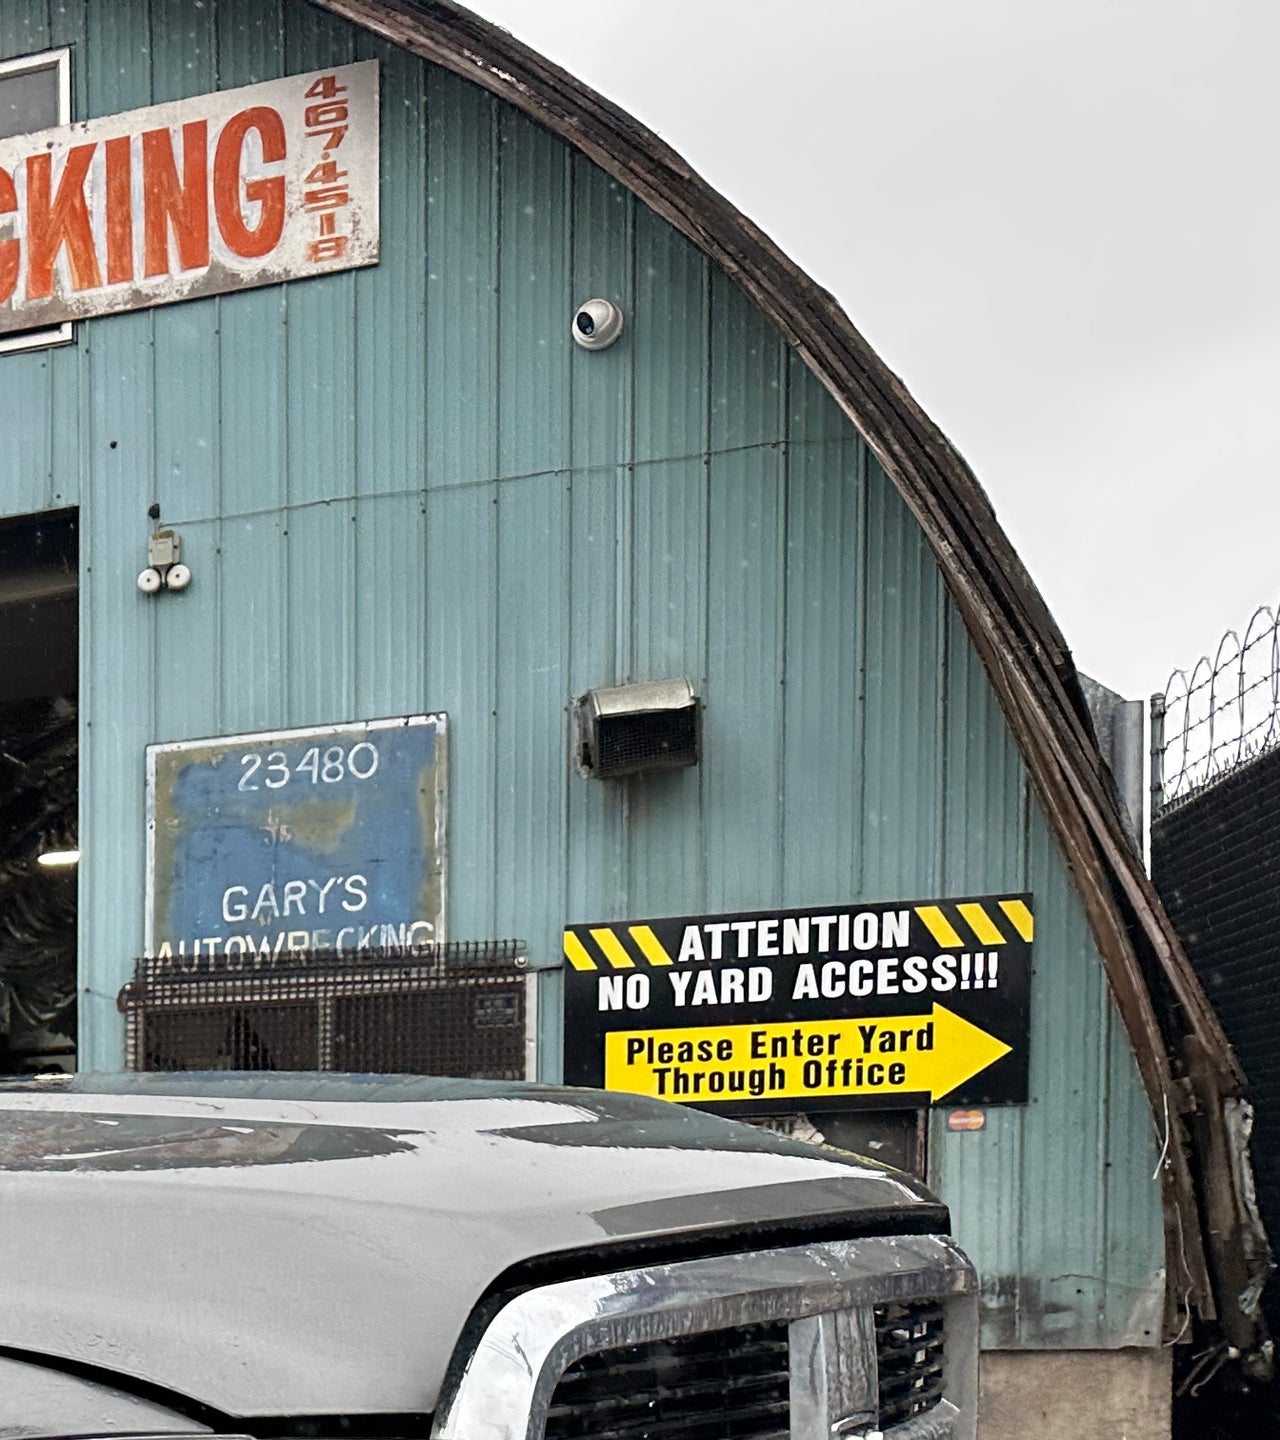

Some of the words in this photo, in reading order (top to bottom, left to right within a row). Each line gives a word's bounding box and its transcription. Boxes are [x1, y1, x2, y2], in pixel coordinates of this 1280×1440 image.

[237, 741, 379, 792] 23480
[222, 873, 368, 923] GARY'S
[154, 920, 434, 972] AUTOWRECKING
[678, 909, 911, 963] ATTENTION
[597, 973, 651, 1012] NO
[668, 965, 773, 1008] YARD
[792, 951, 999, 1000] ACCESS!!!
[626, 1036, 733, 1066] Please
[750, 1029, 842, 1060] Enter
[858, 1021, 935, 1054] Yard
[652, 1061, 786, 1097] Through
[802, 1057, 906, 1088] Office
